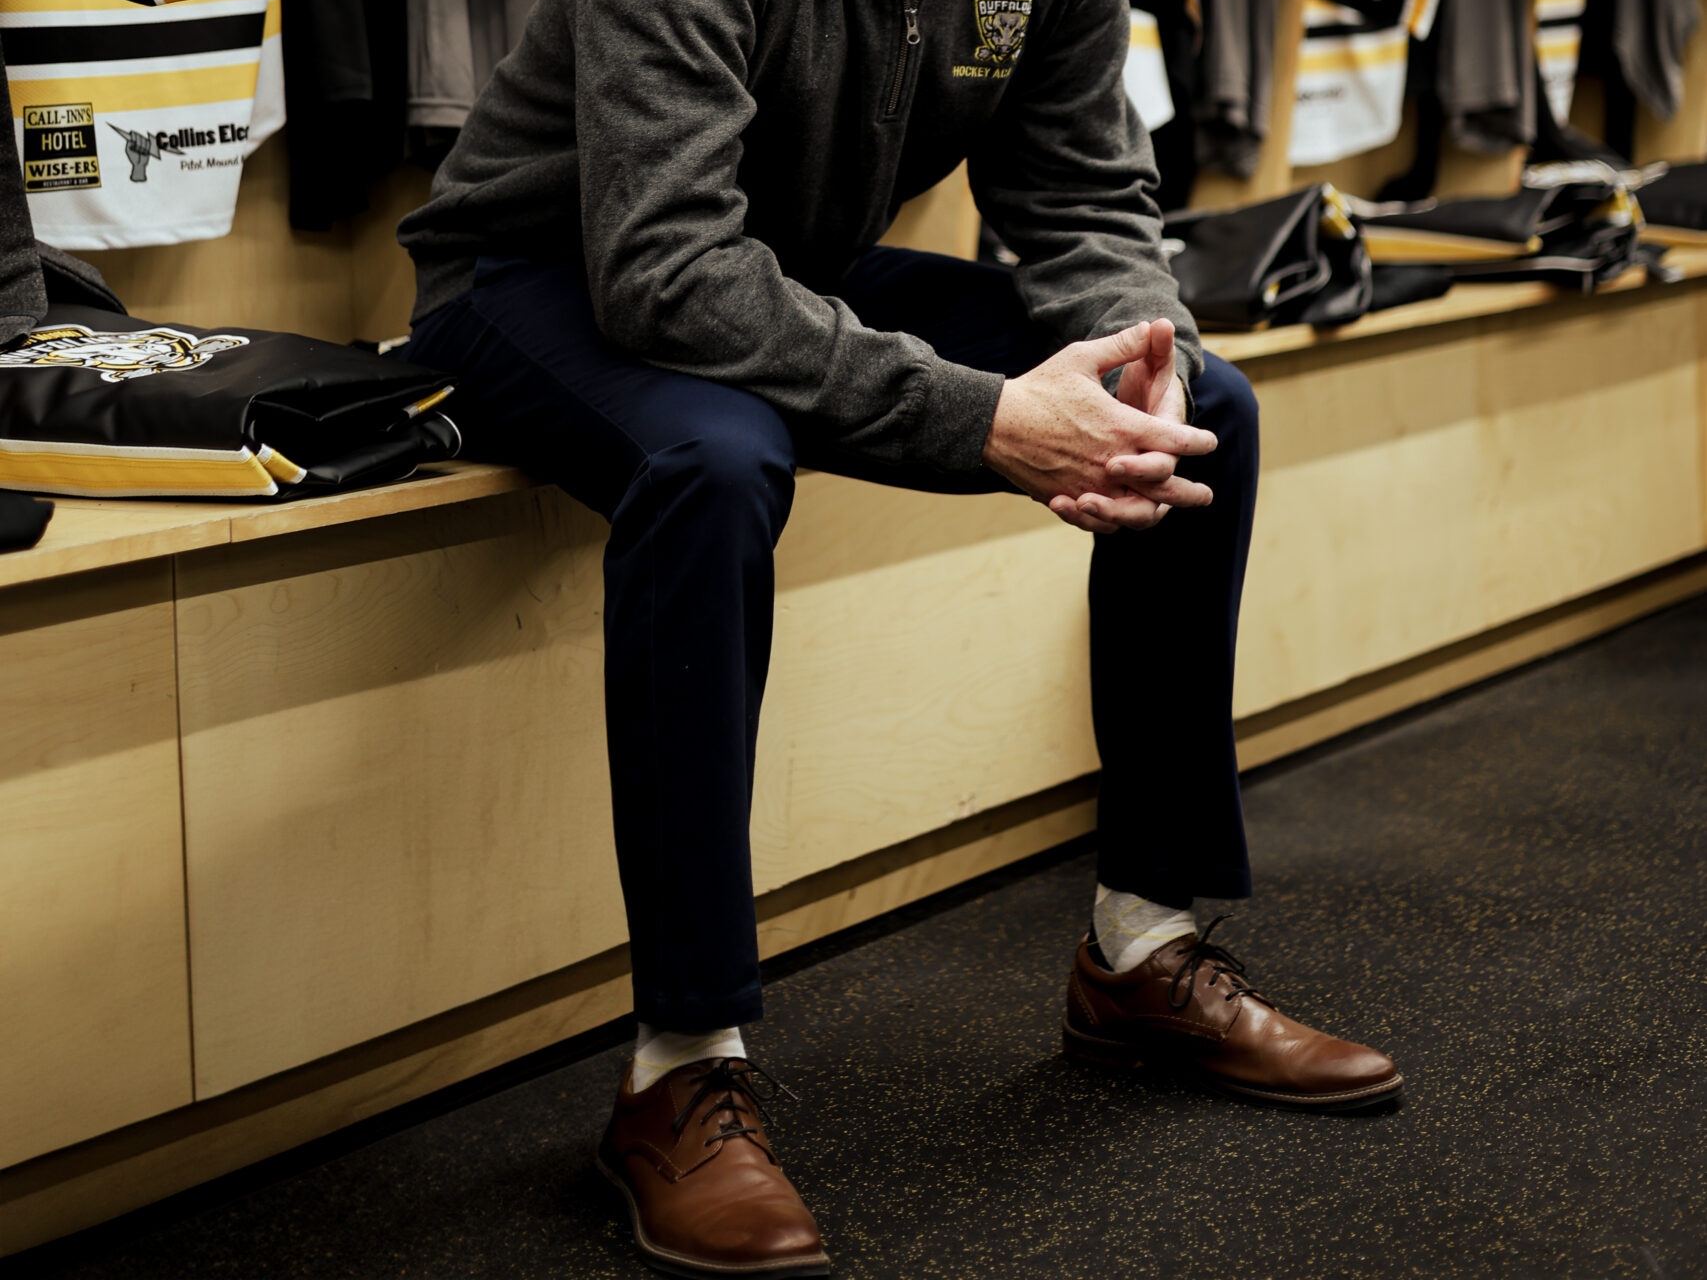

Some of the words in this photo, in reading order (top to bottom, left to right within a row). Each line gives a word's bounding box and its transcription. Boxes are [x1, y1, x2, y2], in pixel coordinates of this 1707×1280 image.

[953, 65, 990, 78] HOCKEY
[41, 131, 87, 151] HOTEL
[156, 127, 216, 150] Collins
[28, 161, 97, 177] WISE-ERS
